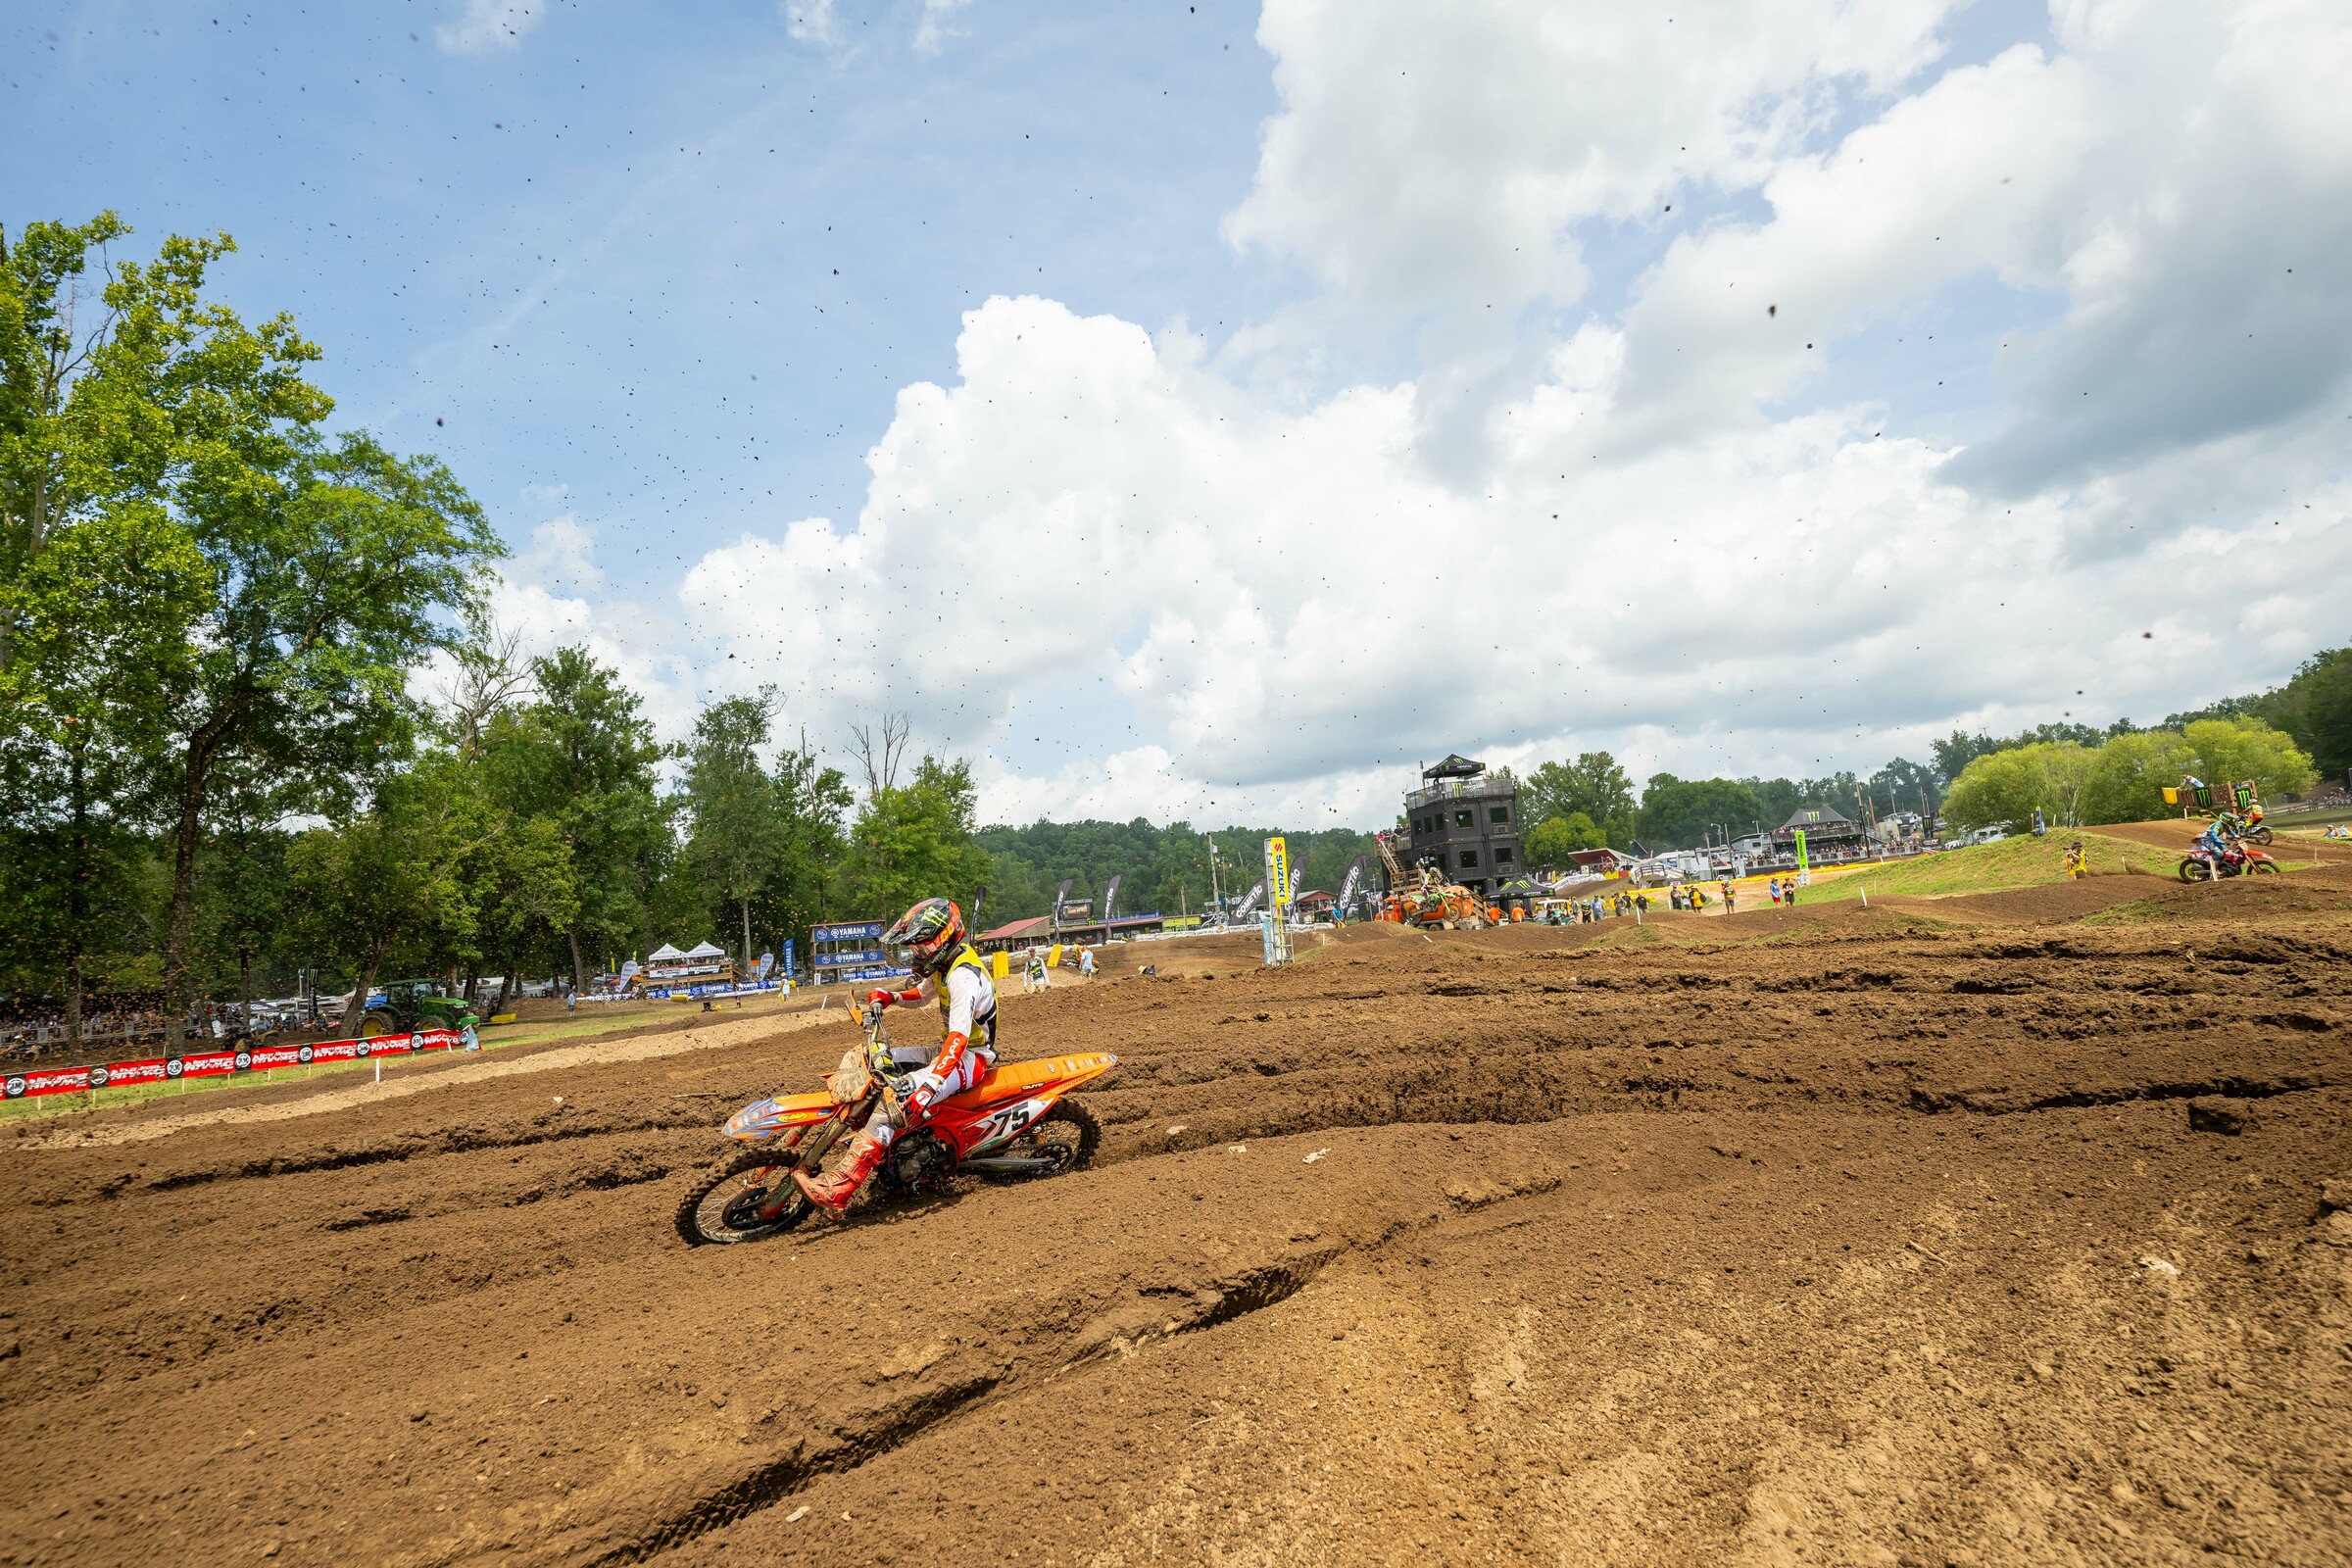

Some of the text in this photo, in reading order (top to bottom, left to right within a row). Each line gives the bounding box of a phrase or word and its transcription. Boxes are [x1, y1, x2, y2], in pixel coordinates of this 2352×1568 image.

[1276, 855, 1286, 900] SUZUKI
[839, 926, 866, 937] YAMAHA
[995, 1102, 1029, 1137] 75
